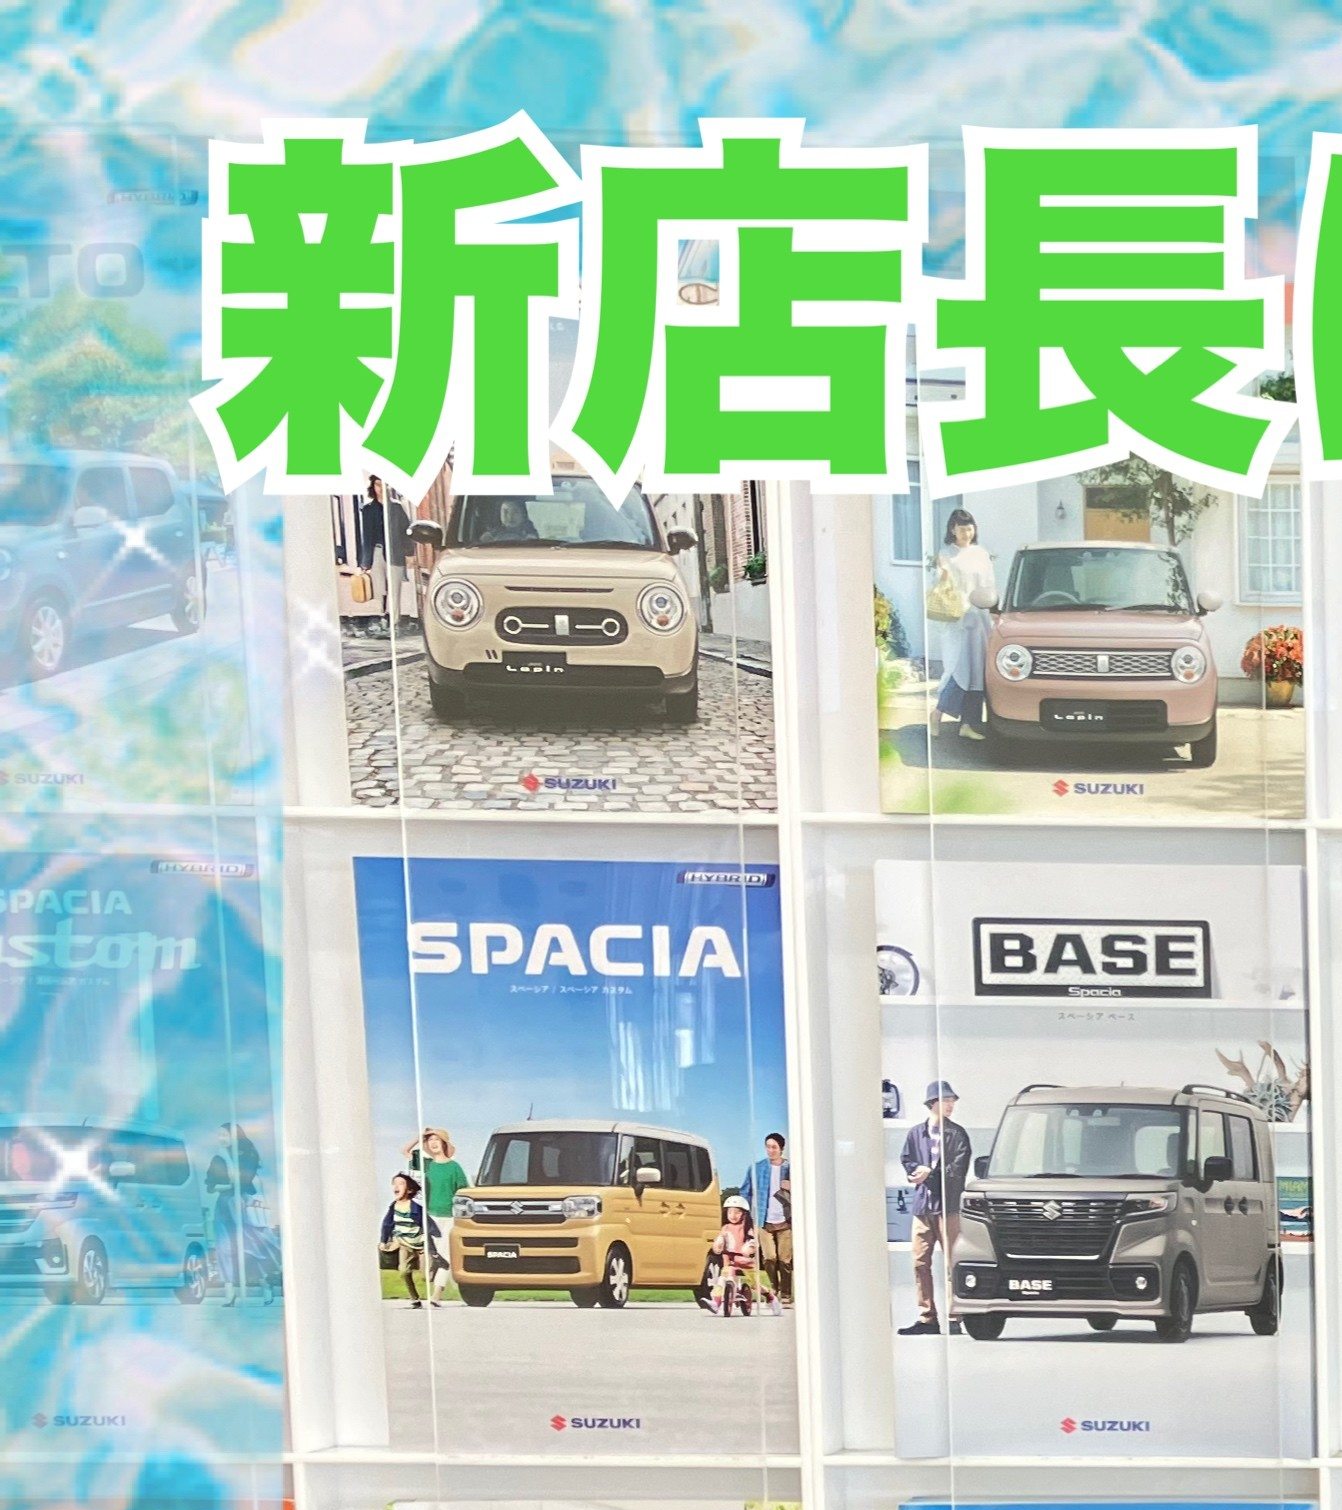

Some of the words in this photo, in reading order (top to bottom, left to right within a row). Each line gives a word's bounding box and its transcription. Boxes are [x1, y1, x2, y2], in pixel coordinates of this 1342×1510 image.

[0, 243, 145, 298] TO
[544, 777, 617, 791] SUZUKI
[1073, 783, 1145, 796] SUZUKI
[684, 871, 767, 887] HYBRID
[0, 889, 132, 915] PACIA
[408, 921, 743, 978] SPACIA
[988, 932, 1198, 977] BASE
[1067, 985, 1123, 998] Spacia
[1008, 1278, 1054, 1292] BASE
[570, 1416, 642, 1430] SUZUKI
[1080, 1420, 1151, 1433] SUZUKI
